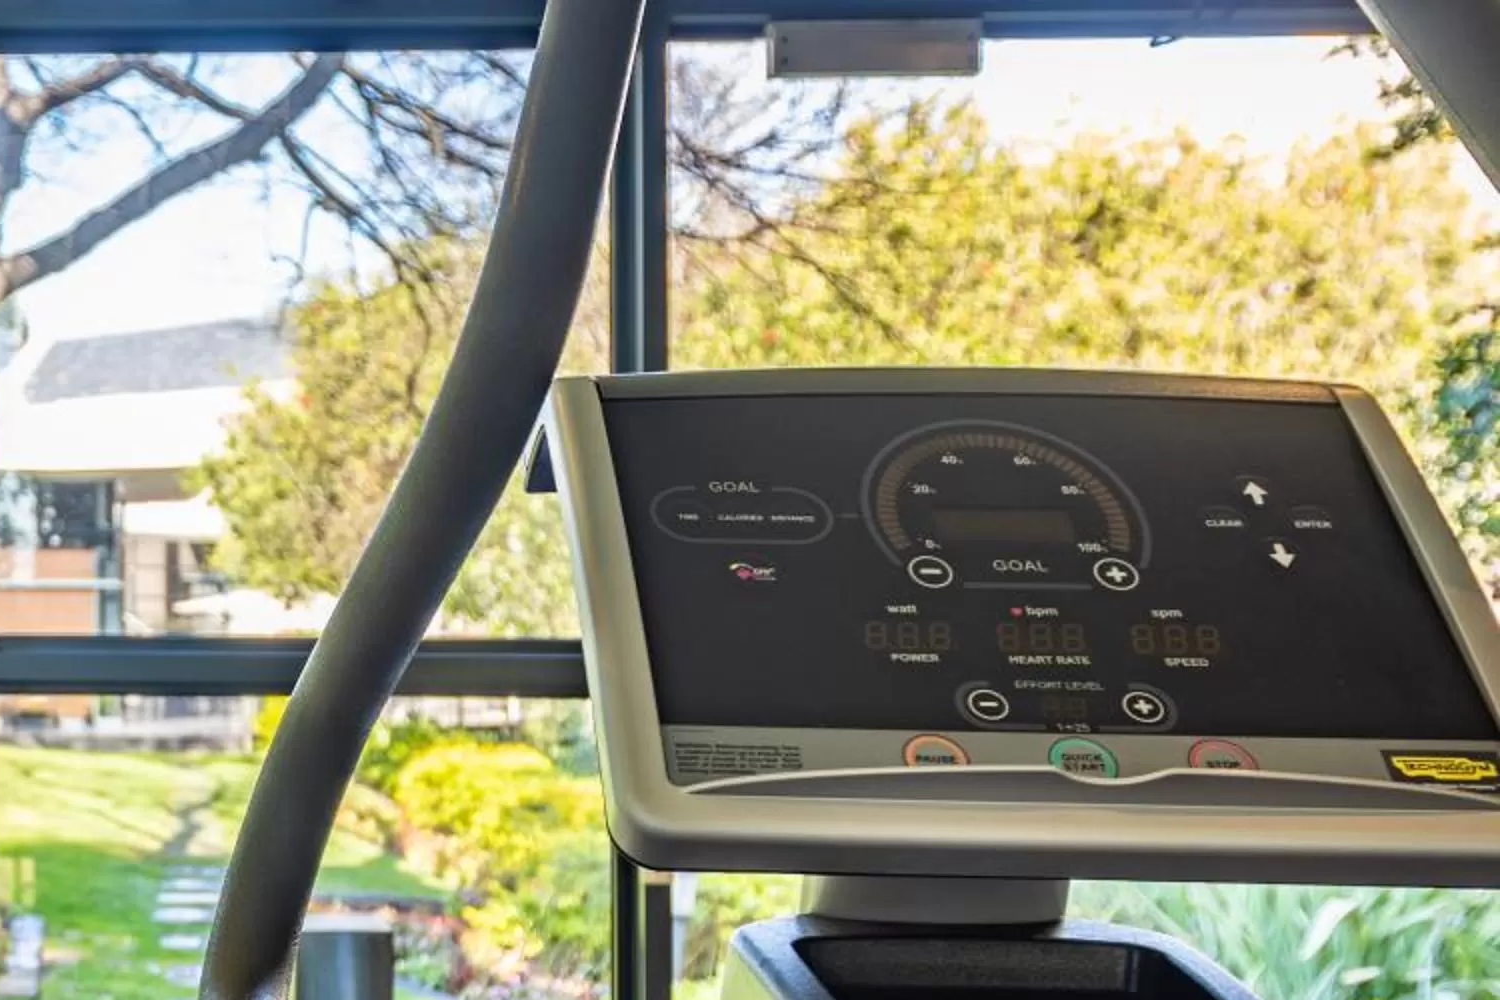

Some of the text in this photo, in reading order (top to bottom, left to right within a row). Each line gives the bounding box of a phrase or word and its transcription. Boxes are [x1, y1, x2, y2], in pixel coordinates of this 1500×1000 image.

[708, 481, 761, 493] GOAL
[1205, 518, 1244, 527] CLEAR
[992, 559, 1048, 573] GOAL
[886, 604, 917, 614] watt
[1025, 606, 1059, 617] bpm
[890, 653, 940, 663] POWER
[1009, 655, 1091, 666] HEART RATE
[1164, 657, 1210, 668] SPEED
[1014, 679, 1105, 691] EFFORT LEVEL
